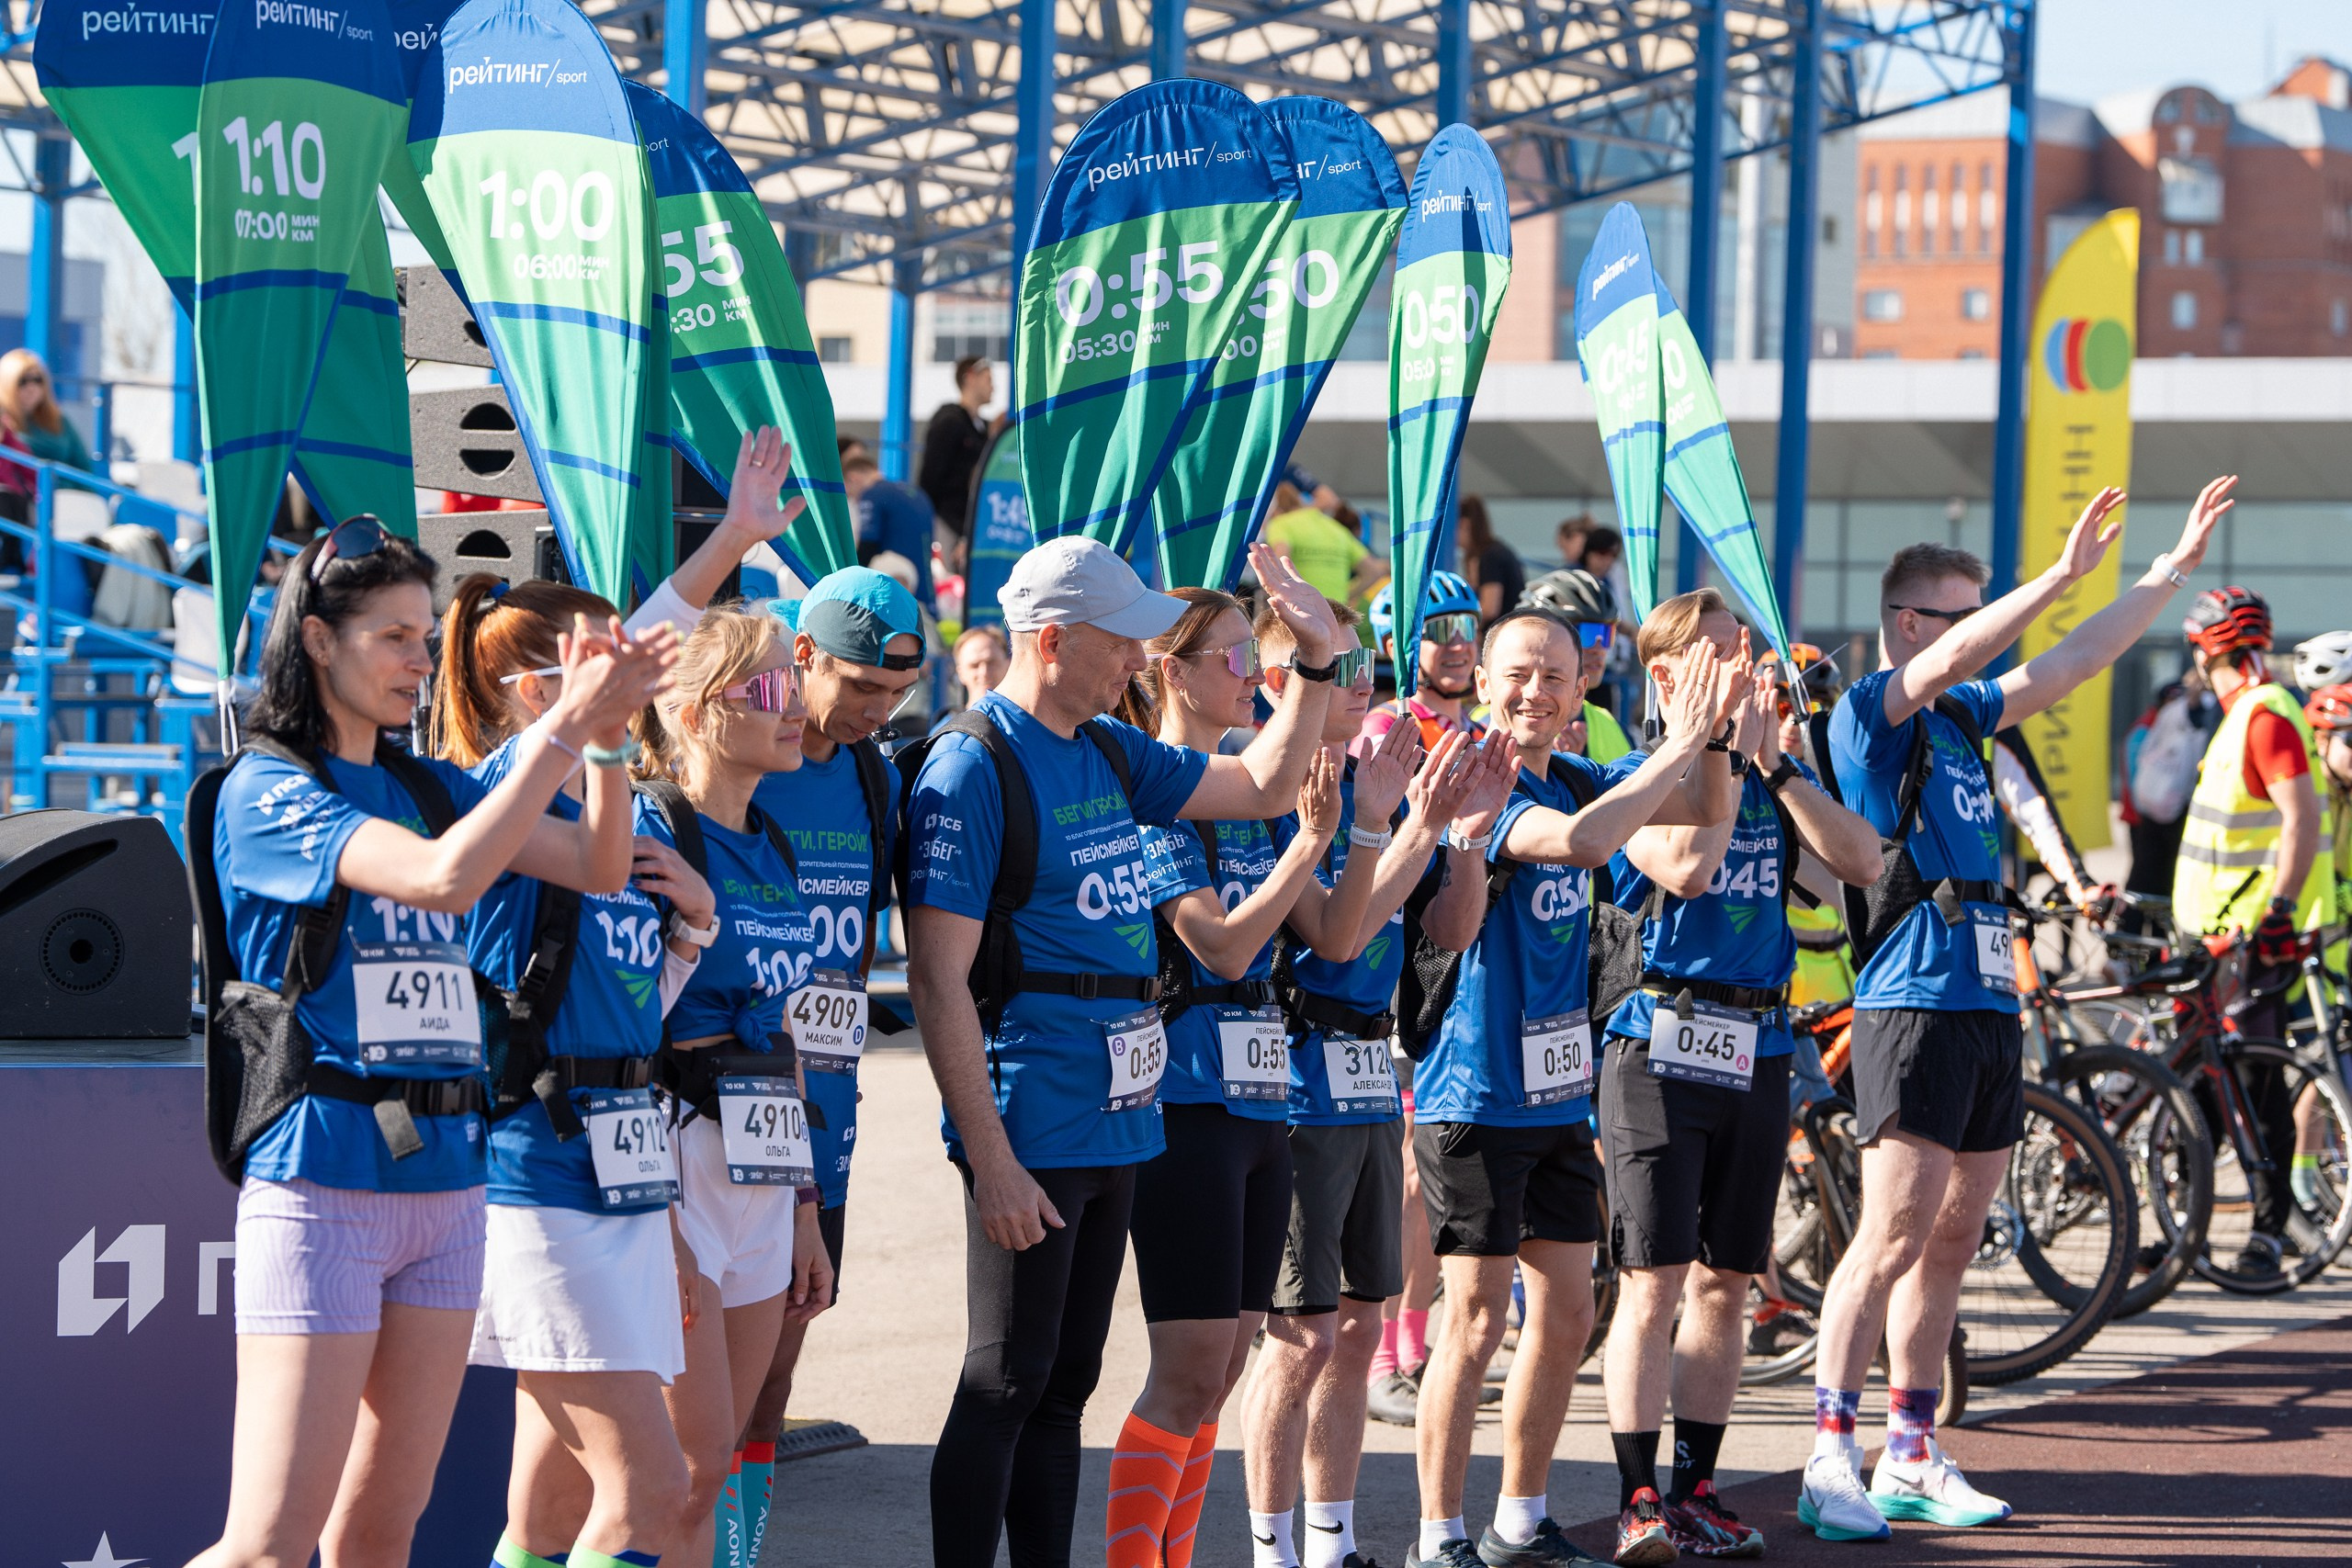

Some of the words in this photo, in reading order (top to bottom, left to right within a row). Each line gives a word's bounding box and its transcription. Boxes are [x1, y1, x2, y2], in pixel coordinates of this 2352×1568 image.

[222, 116, 326, 199] 1:10
[234, 209, 288, 241] 07:00
[478, 169, 615, 243] 1:00
[513, 253, 579, 280] 06:00
[661, 220, 745, 299] 55
[1056, 241, 1224, 328] 0:55
[1238, 249, 1340, 325] 50
[670, 303, 717, 334] :30
[1059, 329, 1136, 365] 05:30
[798, 860, 837, 869] ВОРИТЕЛЬНЫЙ
[1076, 860, 1152, 921] 0:55
[594, 910, 662, 968] 1:10
[808, 904, 864, 958] 00
[385, 970, 463, 1011] 4911
[419, 1017, 450, 1032] АИДА
[792, 991, 857, 1031] 4909
[804, 1031, 843, 1046] МАКСИМ
[1247, 1037, 1285, 1070] 0:55
[1678, 1026, 1736, 1061] 0:45
[1130, 1037, 1161, 1079] 0:55
[1544, 1041, 1581, 1077] 0:50
[614, 1116, 666, 1155] 4912
[744, 1103, 801, 1140] 4910
[765, 1145, 791, 1157] ОЛЬГА
